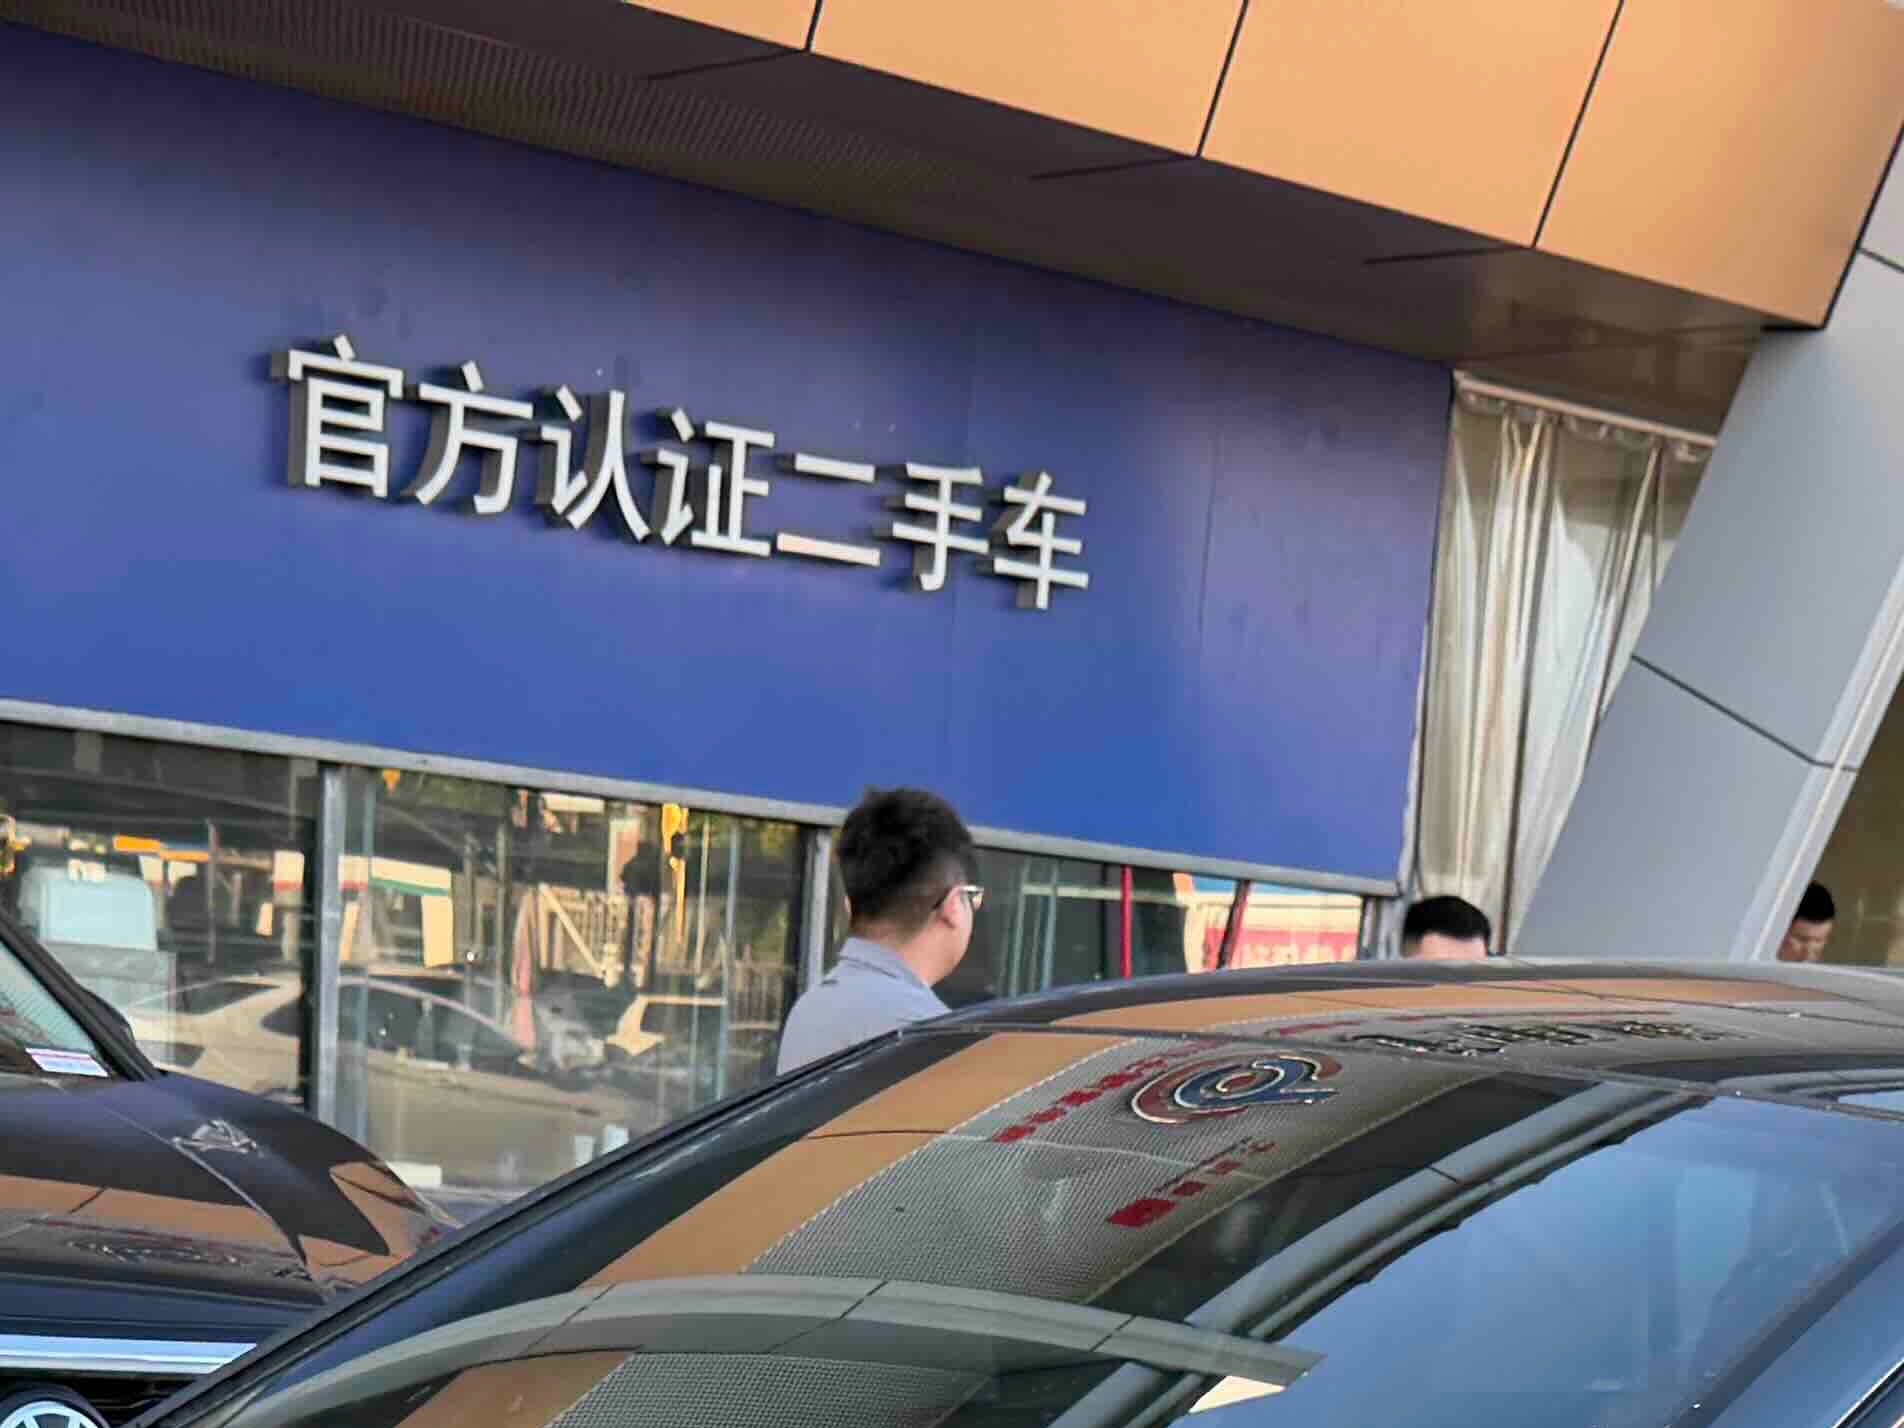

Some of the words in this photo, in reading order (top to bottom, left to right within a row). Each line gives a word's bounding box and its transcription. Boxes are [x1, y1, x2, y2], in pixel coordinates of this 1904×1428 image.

[274, 333, 1089, 610] 官方认证二手车
